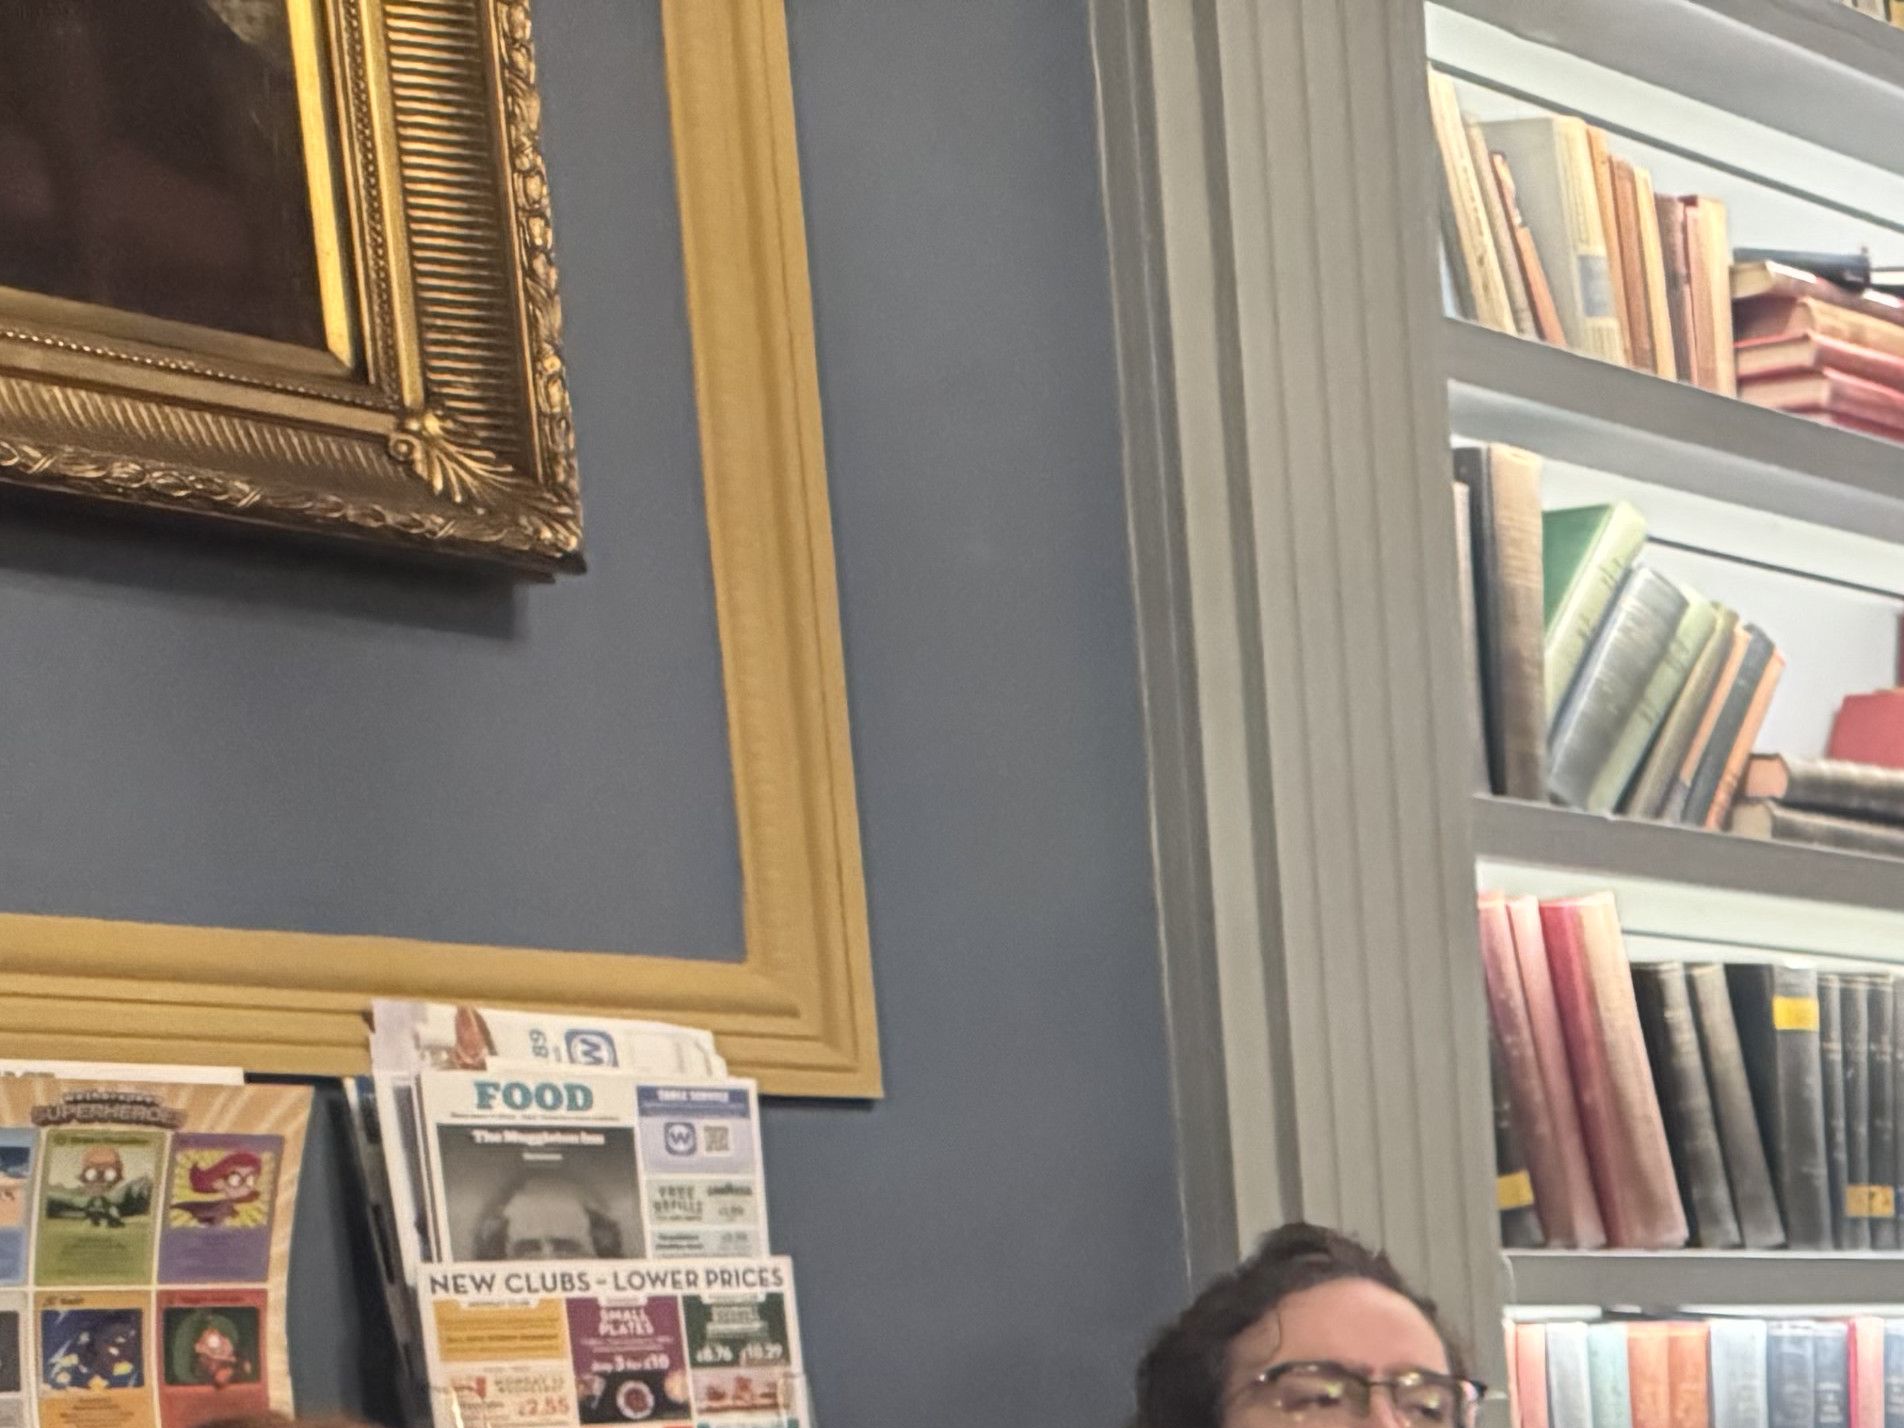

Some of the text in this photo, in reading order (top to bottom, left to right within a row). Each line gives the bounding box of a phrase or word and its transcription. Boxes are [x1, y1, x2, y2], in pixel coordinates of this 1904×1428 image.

[474, 1080, 594, 1112] FOOD
[430, 1273, 496, 1295] NEW
[505, 1273, 591, 1293] CLUBS
[613, 1270, 699, 1291] LOWER
[706, 1267, 784, 1288] PRICES
